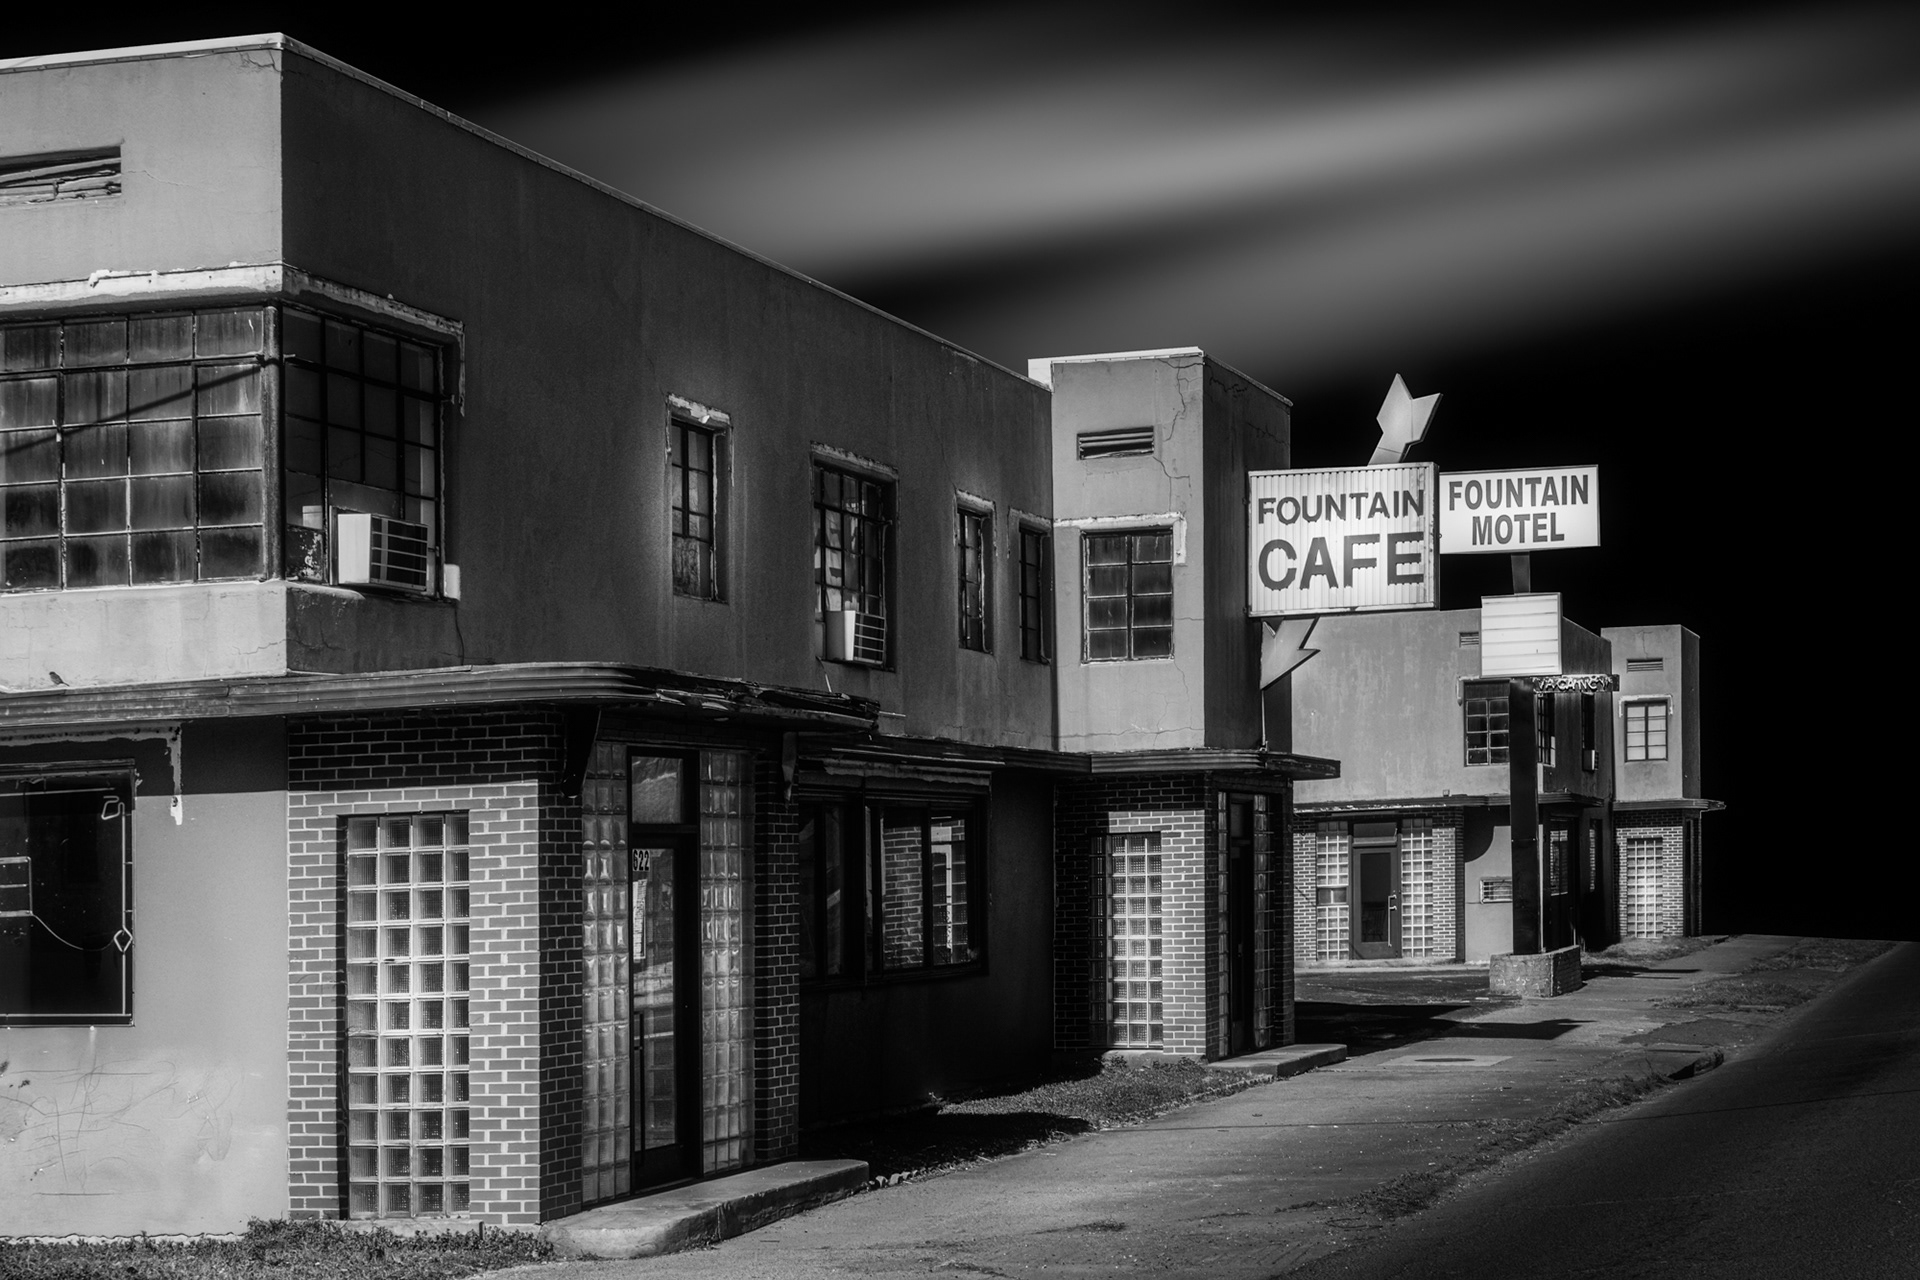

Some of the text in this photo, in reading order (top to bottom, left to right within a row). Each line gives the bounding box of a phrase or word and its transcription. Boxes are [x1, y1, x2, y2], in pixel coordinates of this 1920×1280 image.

[1258, 490, 1424, 525] FOUNTAIN
[1449, 474, 1589, 511] FOUNTAIN
[1472, 512, 1565, 546] MOTEL
[1258, 532, 1425, 591] CAFE
[634, 850, 649, 870] 622
